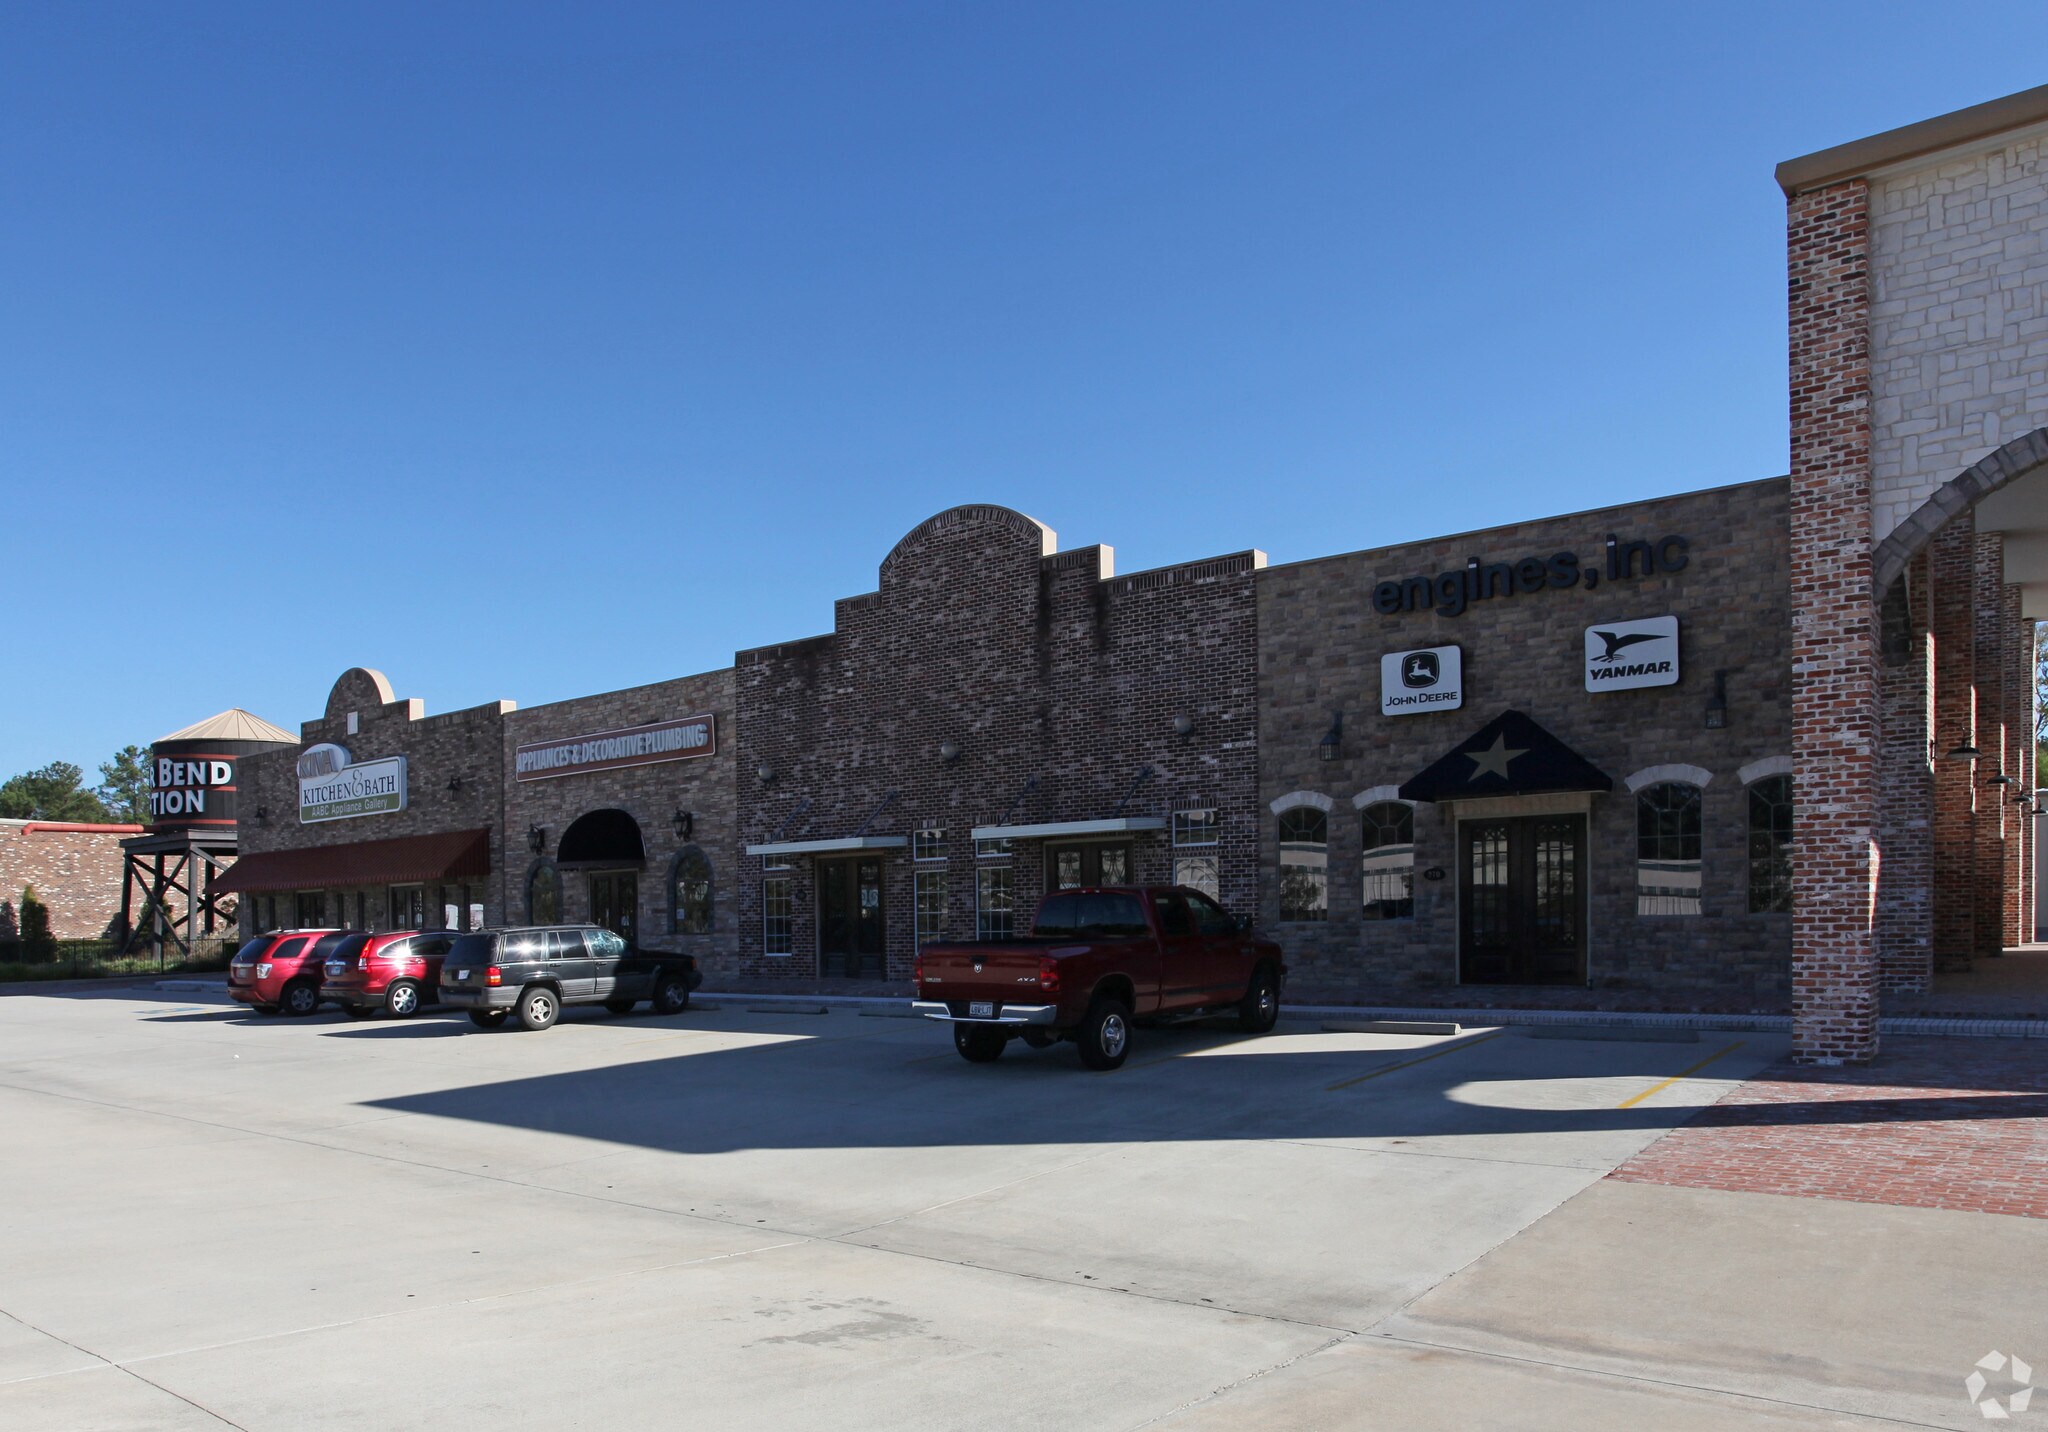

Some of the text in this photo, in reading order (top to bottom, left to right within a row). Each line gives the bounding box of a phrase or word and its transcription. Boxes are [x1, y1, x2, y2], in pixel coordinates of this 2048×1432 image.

[1590, 661, 1671, 680] YANMAR
[1385, 691, 1458, 706] JOHN DEERE
[516, 745, 572, 773] APPLIANCES
[582, 733, 645, 763] DECORATIVE
[645, 723, 708, 753] PLUMBING
[158, 757, 232, 787] BEND
[303, 782, 351, 805] KITCHEN
[364, 775, 395, 796] BATH
[311, 798, 388, 818] AABC Appliance Gallery
